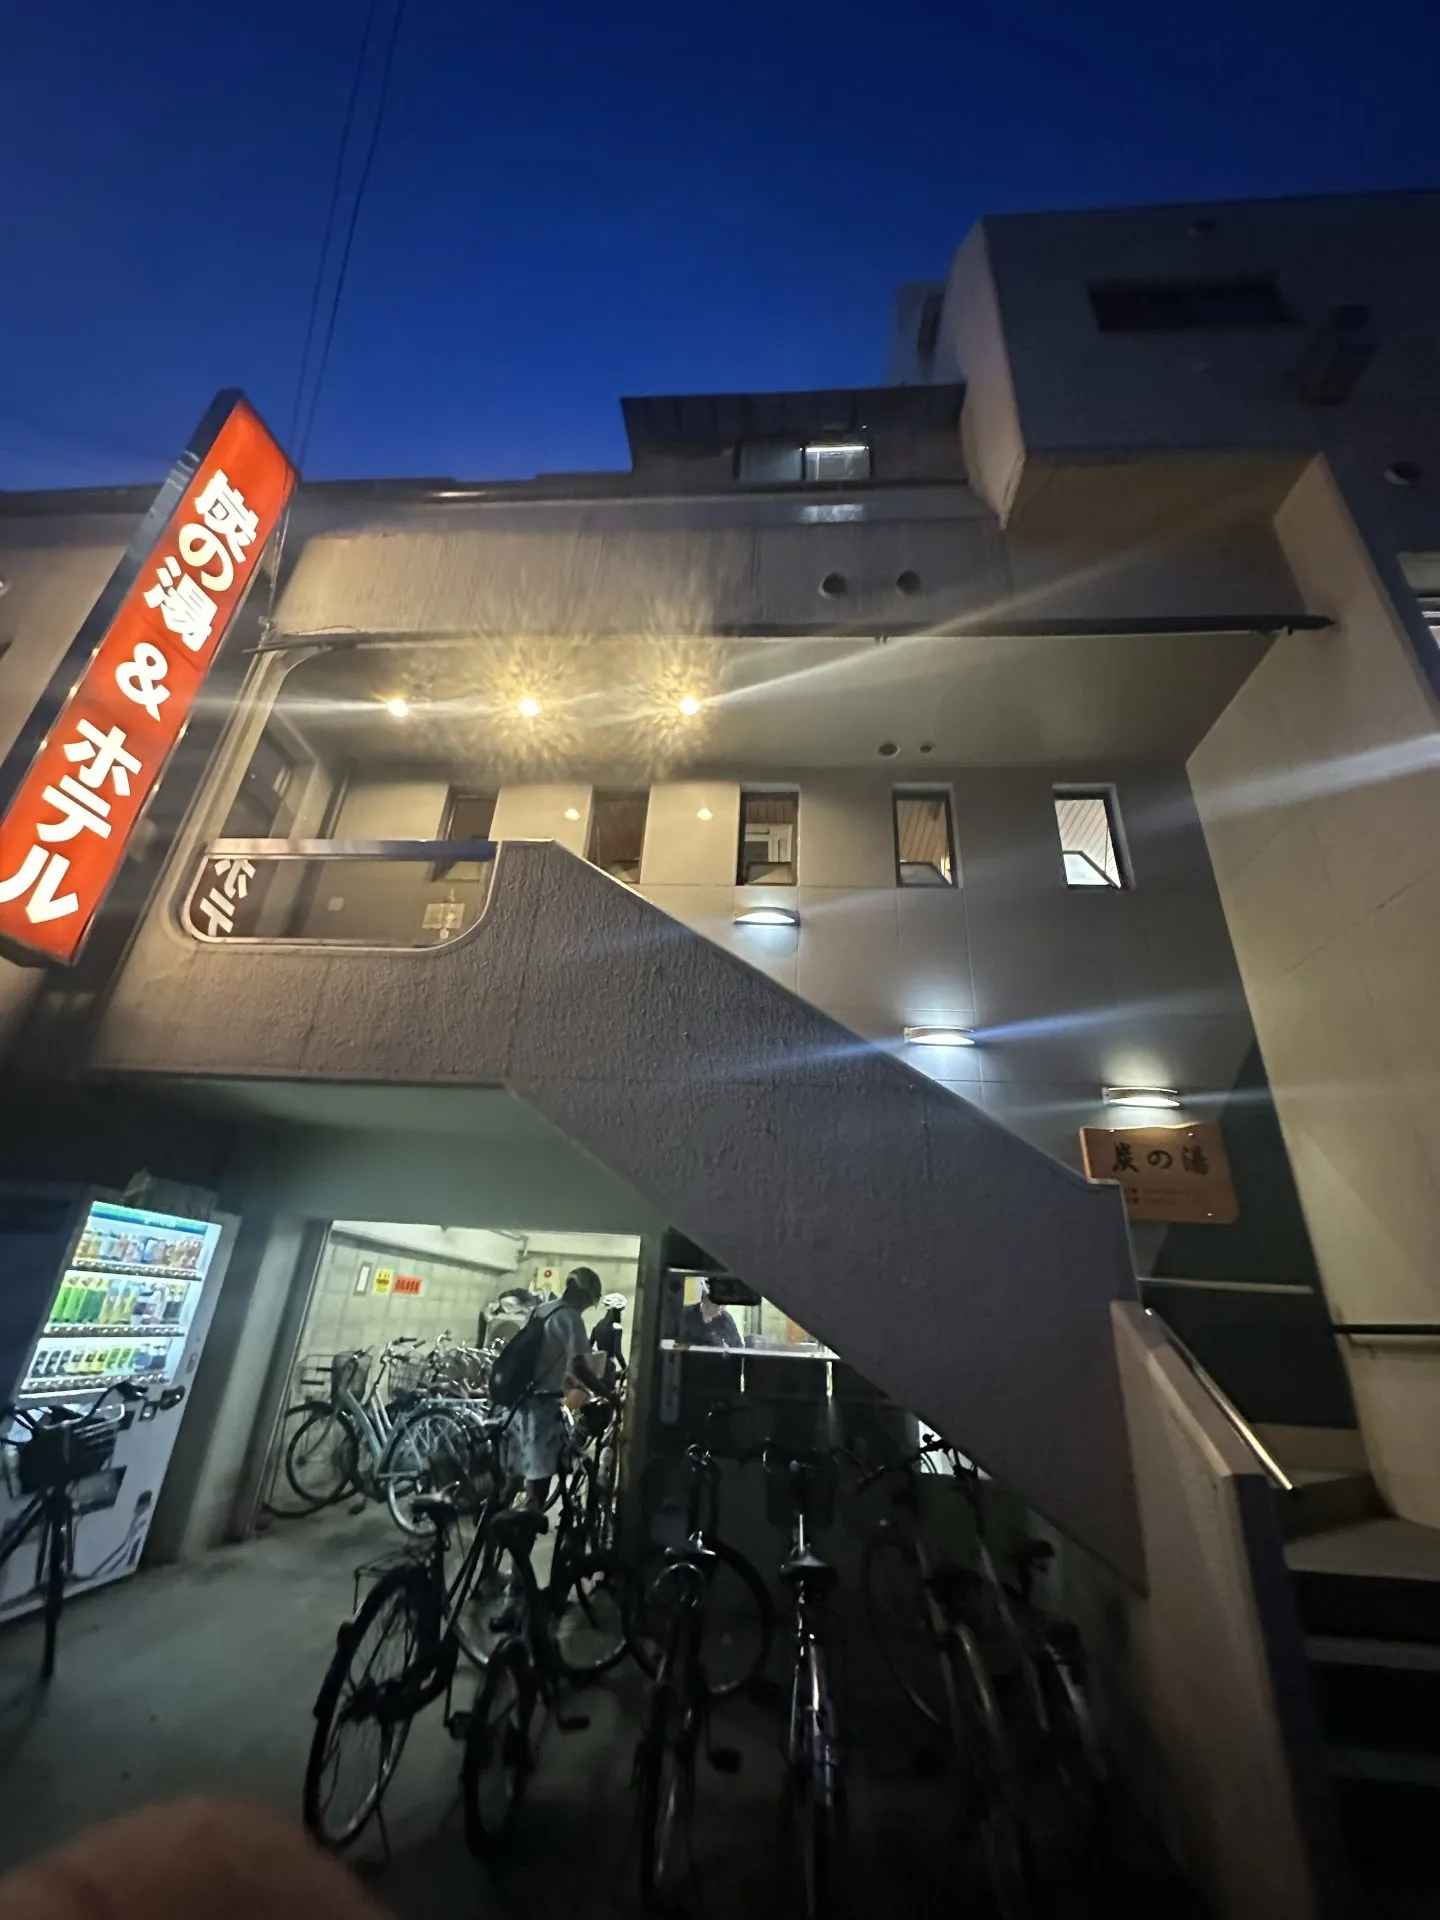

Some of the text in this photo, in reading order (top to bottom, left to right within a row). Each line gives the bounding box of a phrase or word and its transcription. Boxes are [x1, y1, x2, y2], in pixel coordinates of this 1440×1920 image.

[115, 642, 171, 722] &
[0, 718, 143, 924] ホテル
